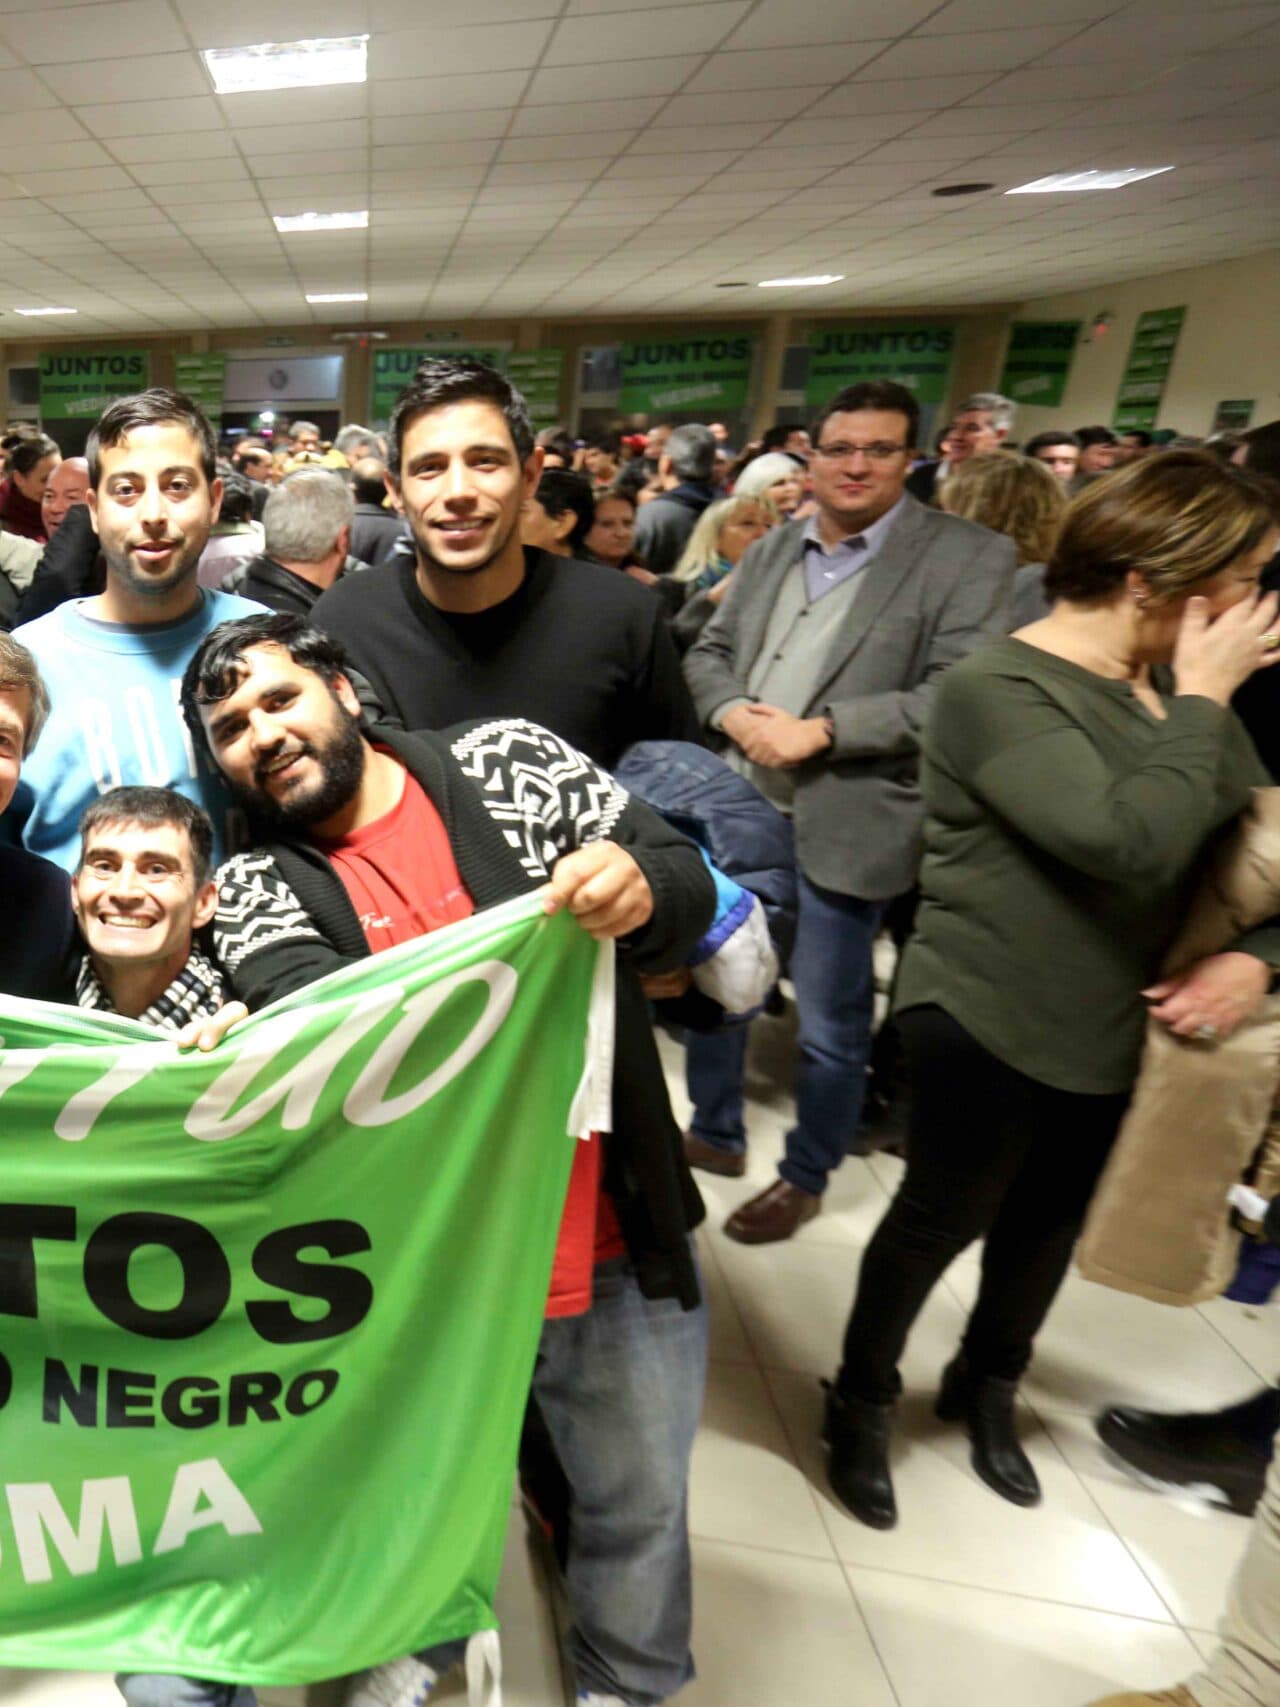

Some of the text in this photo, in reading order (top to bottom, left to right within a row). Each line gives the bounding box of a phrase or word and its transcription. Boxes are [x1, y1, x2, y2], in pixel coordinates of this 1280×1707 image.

[625, 338, 748, 366] JUNTOS
[816, 330, 952, 355] JUNTOS
[43, 355, 143, 376] JUNTOS
[42, 1357, 340, 1430] NEGRO
